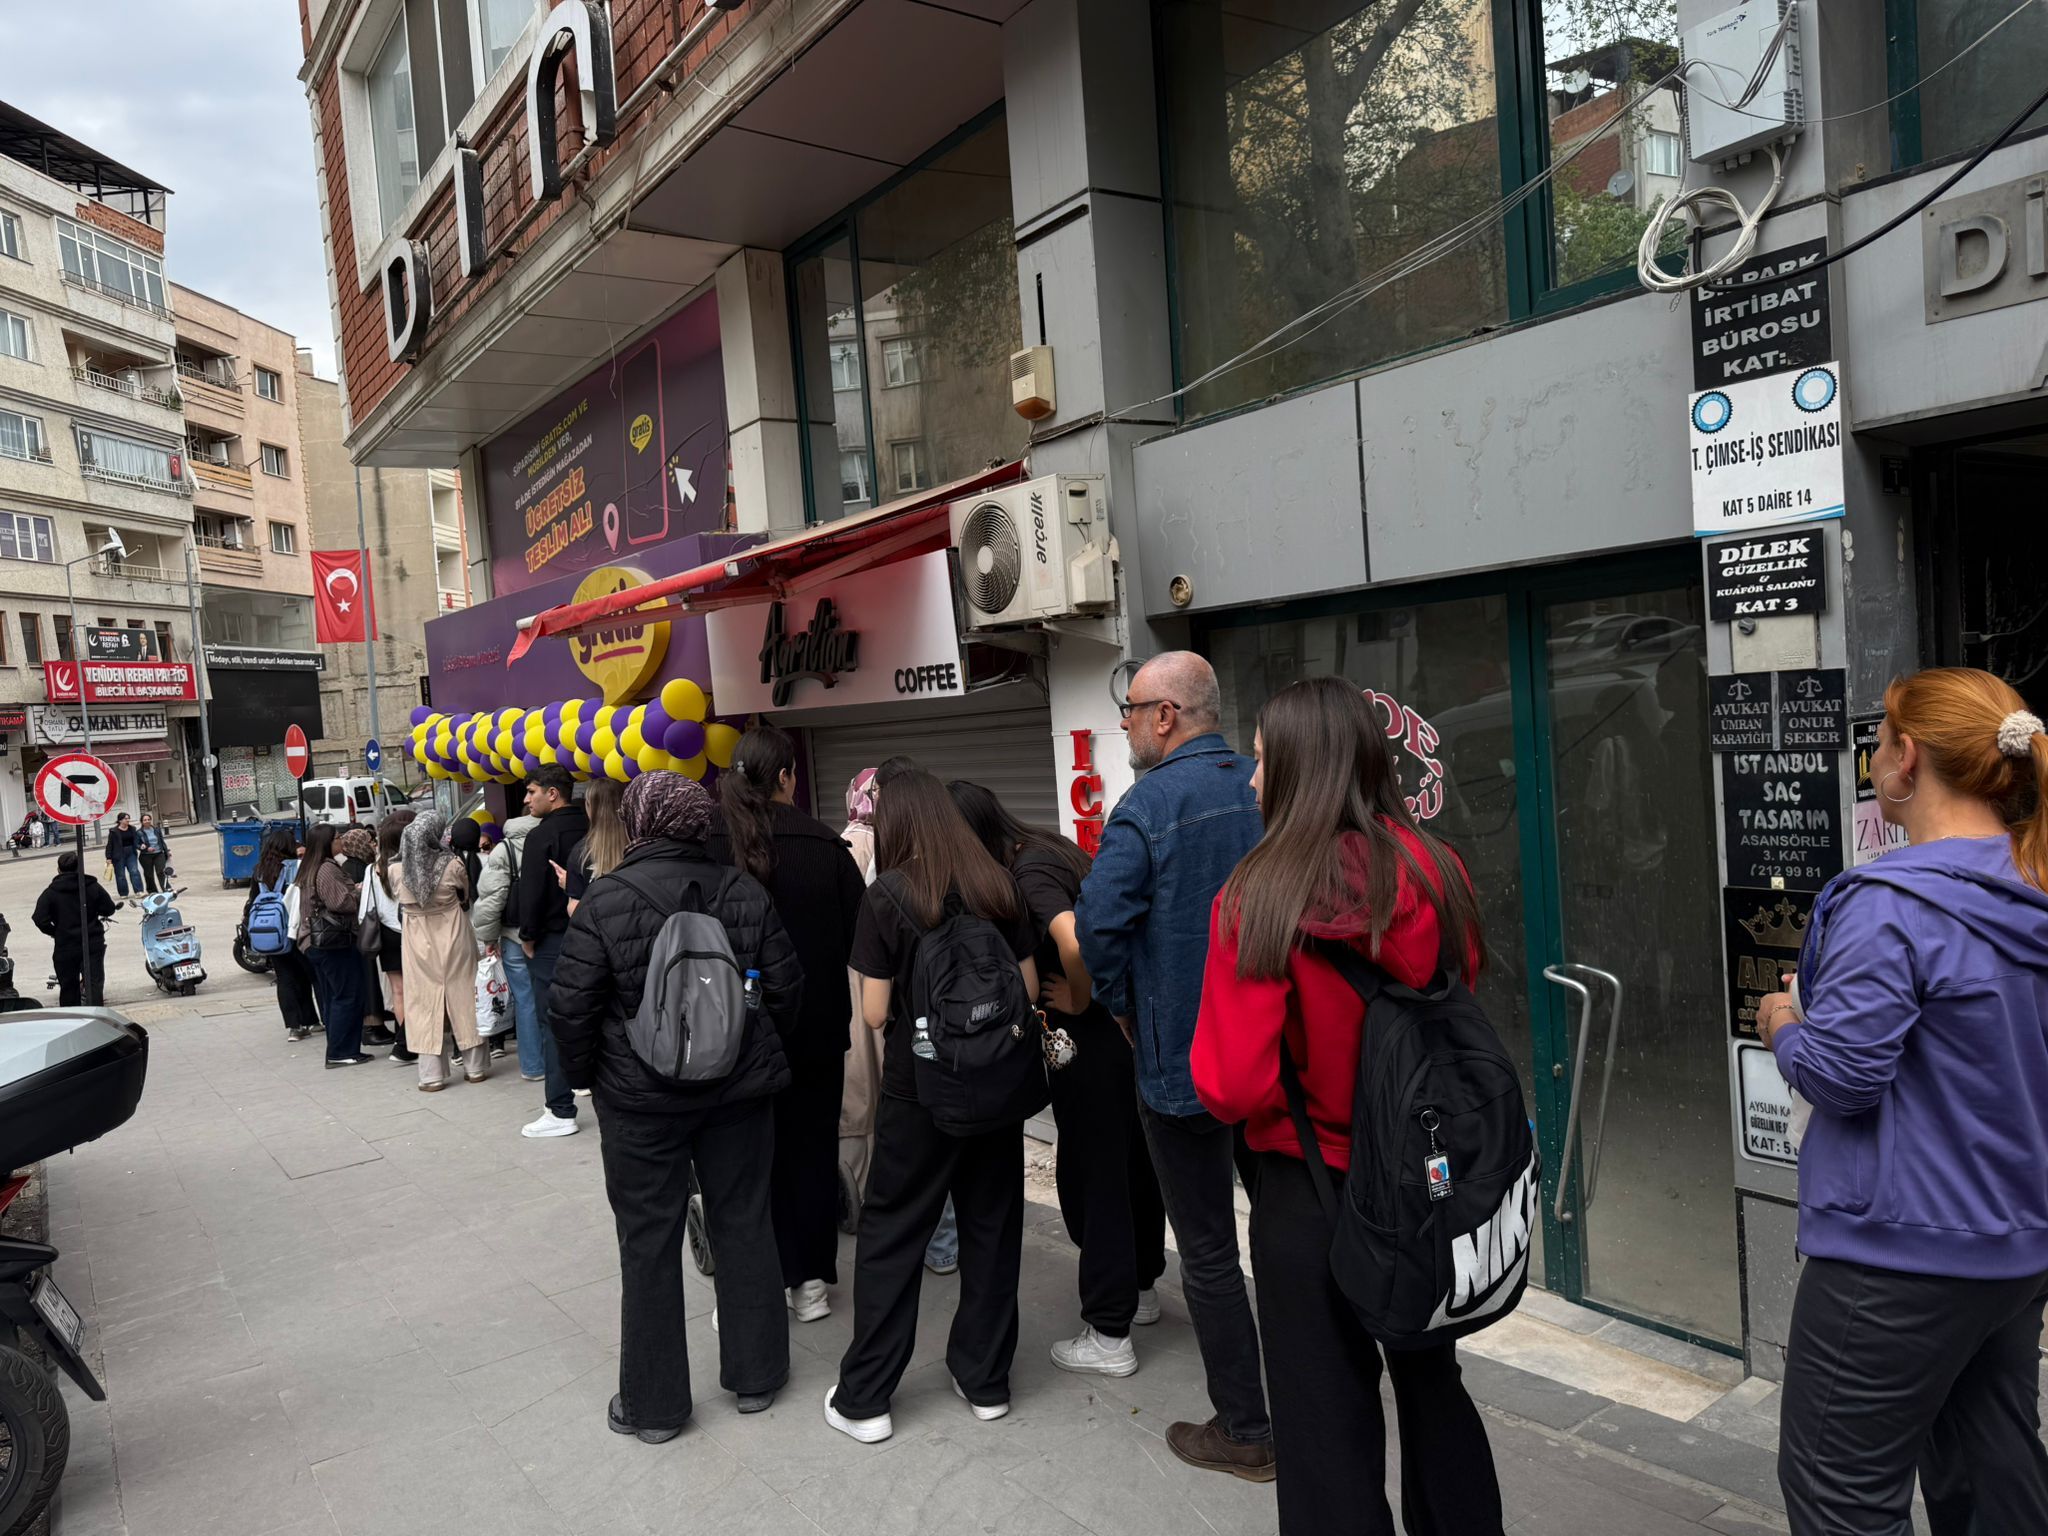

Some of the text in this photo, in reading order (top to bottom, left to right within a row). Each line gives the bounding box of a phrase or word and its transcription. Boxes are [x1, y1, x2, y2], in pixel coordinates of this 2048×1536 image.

[1704, 281, 1817, 327] İRTİBAT
[1702, 308, 1820, 356] BÜROSU
[1723, 350, 1787, 378] KAT:
[632, 416, 650, 443] gratis
[1692, 421, 1840, 475] T. ÇİMSE-İŞ SENDİKASI
[525, 466, 585, 538] ÜCRETSİZ
[1723, 488, 1813, 517] KAT 5 DAİRE 14
[525, 500, 593, 573] TESLİM AL!
[1030, 491, 1047, 564] arçelik
[1719, 537, 1810, 564] DİLEK
[1722, 557, 1808, 577] GÜZELLİK
[1759, 575, 1770, 583] &
[1766, 579, 1816, 591] SALONU
[1734, 597, 1798, 614] KAT 3
[85, 664, 125, 682] YENİDEN
[125, 667, 154, 682] REFAH
[895, 663, 958, 693] COFFEE
[96, 683, 183, 698] BİLECİK İL BAŞKANLIĞI
[1712, 702, 1769, 716] AVUKAT
[1780, 699, 1841, 713] AVUKAT
[131, 712, 165, 730] TATLI
[1720, 718, 1762, 730] ÜMRAN
[1788, 717, 1836, 729] ONUR
[1712, 730, 1772, 745] KARAYİĞİT
[1784, 731, 1840, 745] ŞEKER
[1734, 752, 1829, 774] İSTANBUL
[1763, 781, 1801, 805] SAÇ
[1738, 809, 1830, 830] TASARIM
[1740, 834, 1830, 847] ASANSÖRLE
[1763, 850, 1807, 861] 3. KAT
[1785, 866, 1801, 877] 99
[1806, 866, 1821, 877] 81
[971, 1000, 999, 1021] NIKE
[1749, 1101, 1778, 1115] AYSUN
[1783, 1141, 1791, 1155] 5
[1451, 1150, 1542, 1310] NIKE
